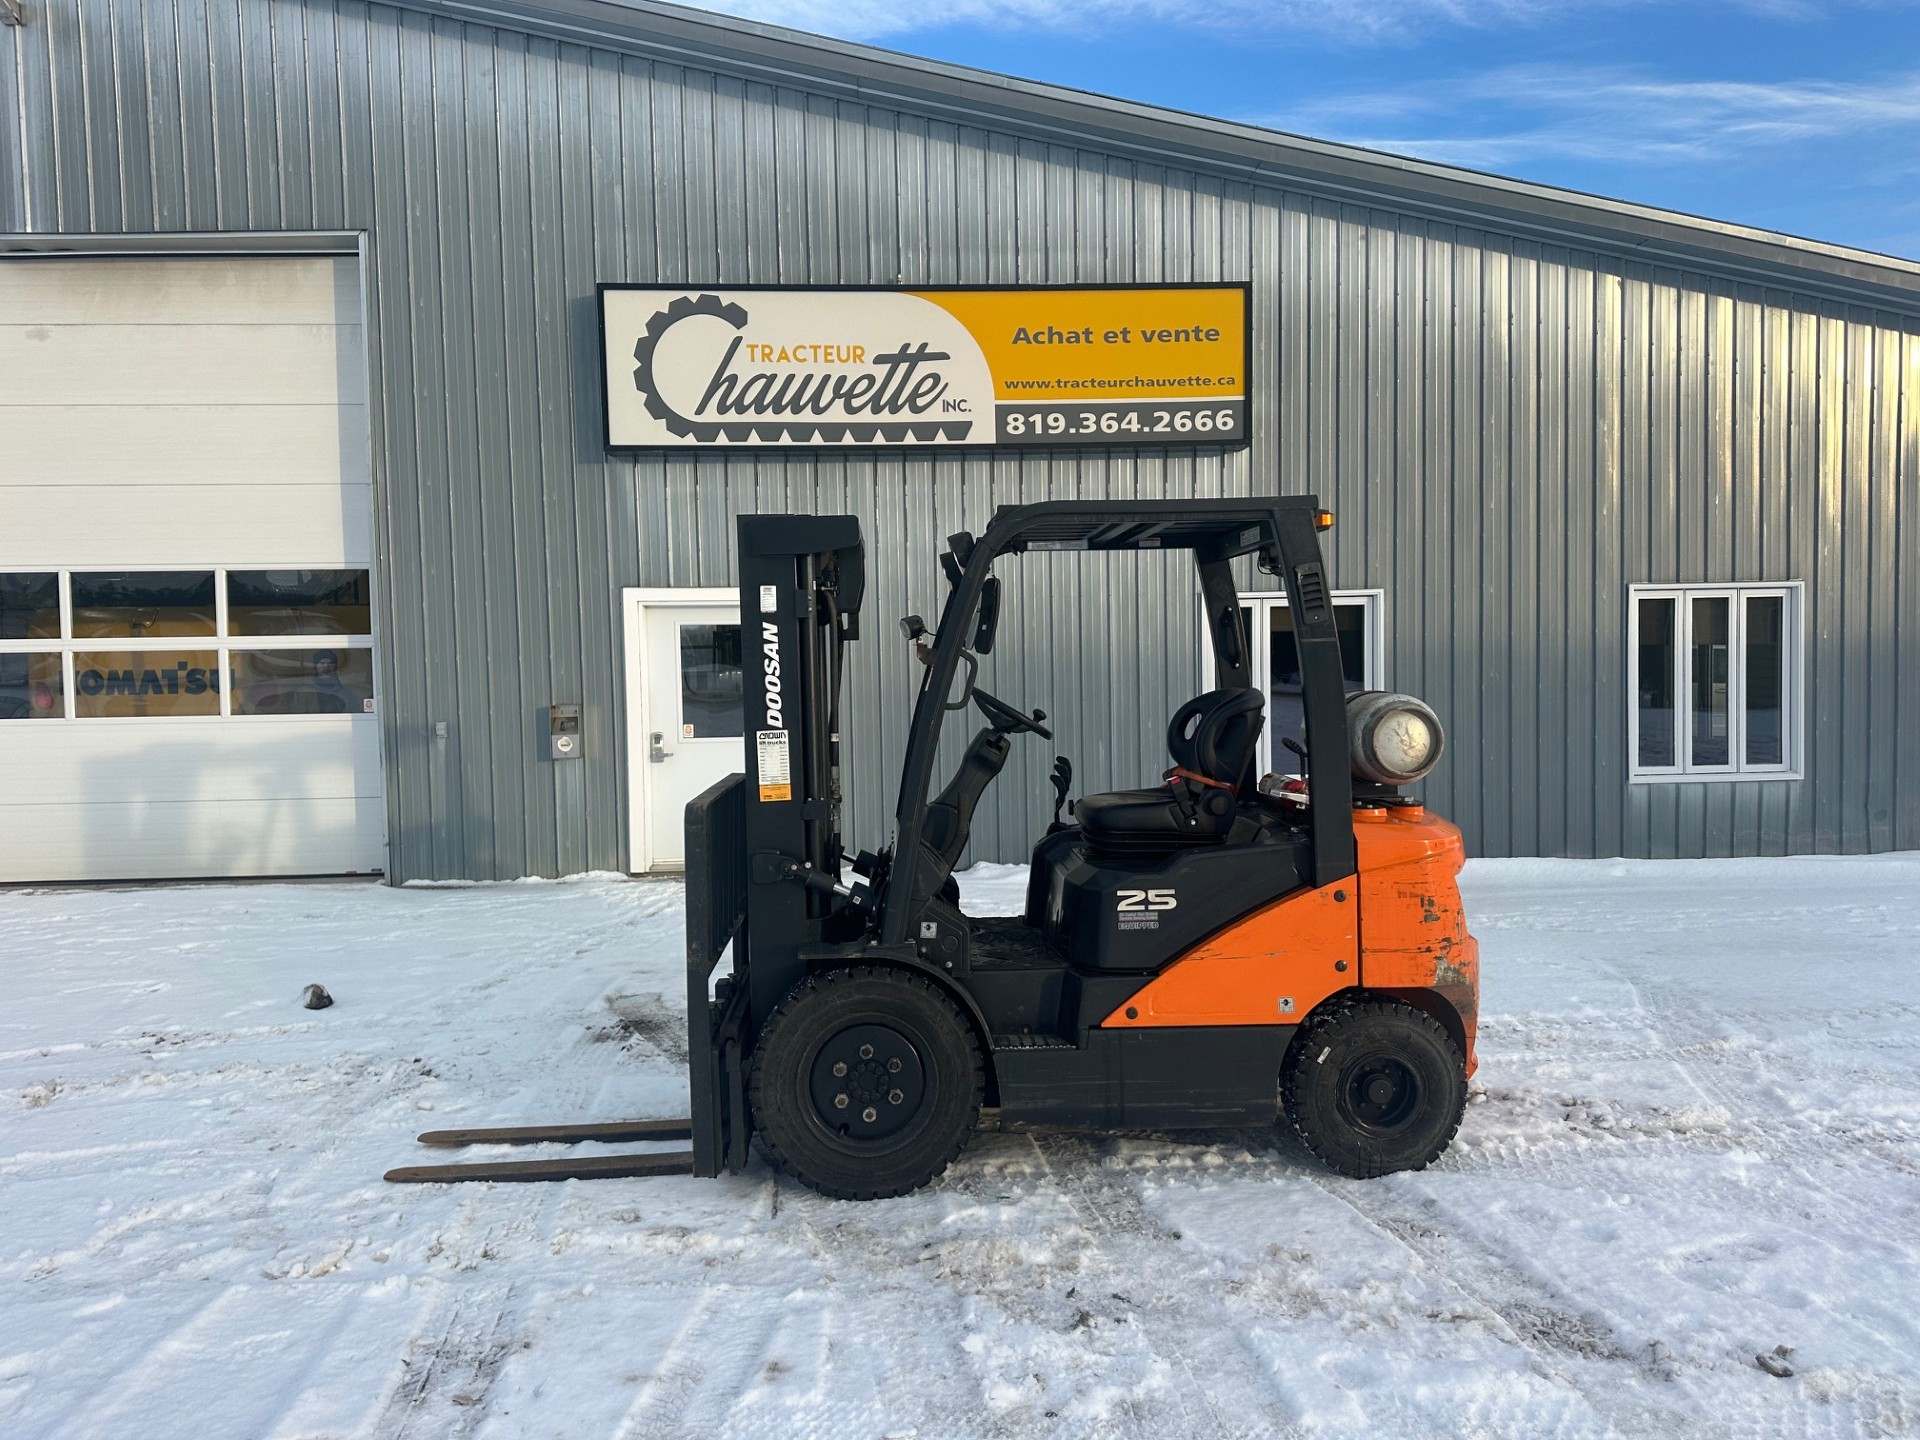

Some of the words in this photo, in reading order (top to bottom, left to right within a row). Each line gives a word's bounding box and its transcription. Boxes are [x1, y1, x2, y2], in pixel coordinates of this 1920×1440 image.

[1011, 325, 1094, 345] Achat
[1103, 326, 1131, 344] et
[1140, 325, 1220, 343] vente
[745, 343, 865, 364] TRACTEUR
[633, 293, 951, 442] Chauvette
[941, 398, 972, 413] INC.
[1004, 375, 1236, 389] www.tracteurchauvette.ca
[1005, 409, 1235, 435] 819.364.2666
[762, 621, 783, 729] DOOSAN
[1116, 888, 1178, 911] 25
